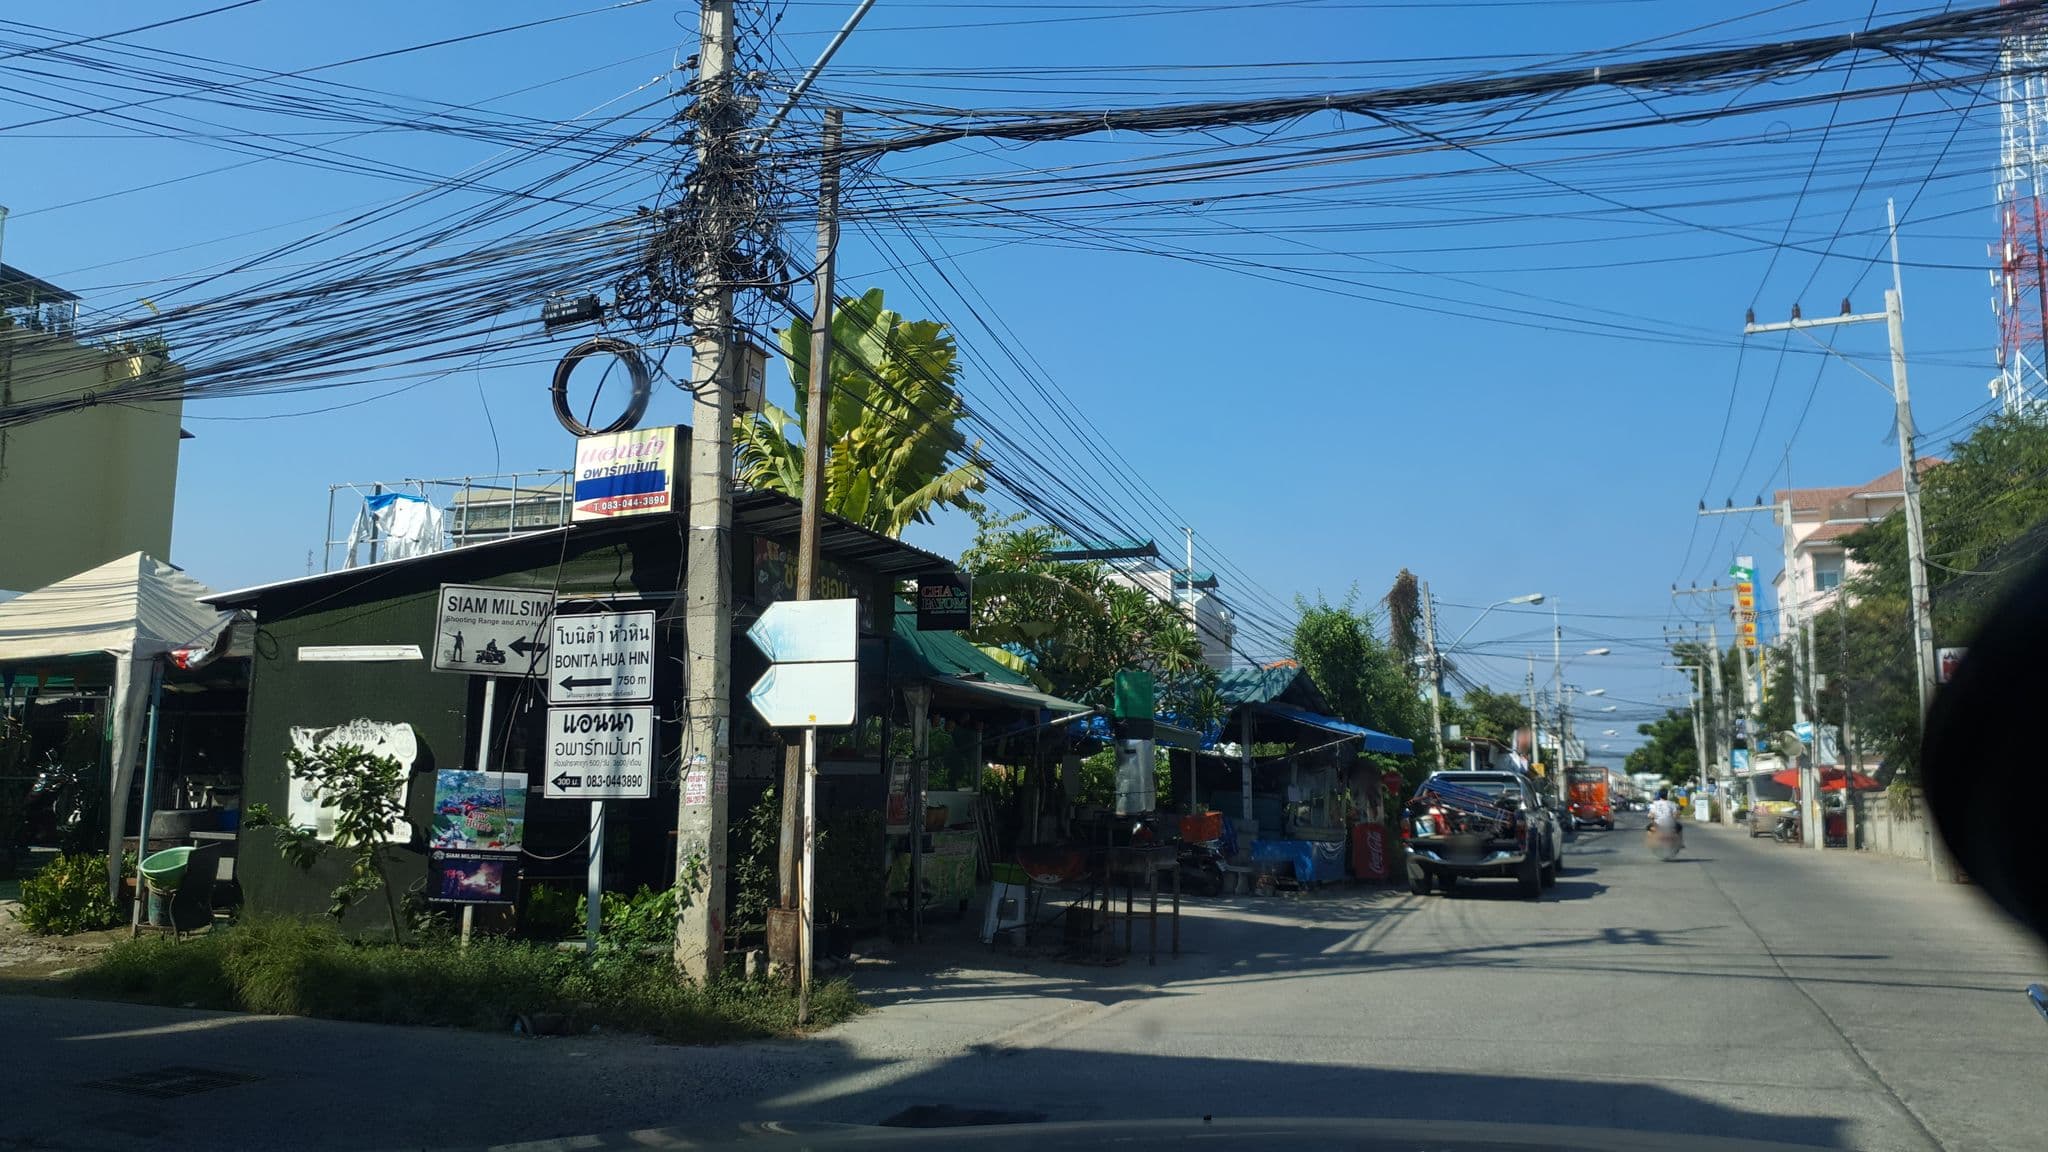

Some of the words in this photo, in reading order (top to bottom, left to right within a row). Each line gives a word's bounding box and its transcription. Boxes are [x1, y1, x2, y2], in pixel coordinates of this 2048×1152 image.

[448, 596, 487, 614] SIAM
[492, 599, 550, 617] MILSIM
[445, 615, 477, 625] Shooting
[479, 617, 500, 626] Range
[515, 619, 530, 627] ATV
[557, 624, 604, 645] โบนิต้า
[609, 622, 650, 643] หัวหิน
[555, 653, 598, 669] BONITA
[601, 652, 626, 667] HUA
[629, 651, 649, 666] HIN
[617, 675, 636, 686] 750
[637, 676, 647, 685] m
[563, 712, 634, 734] แอนนา
[555, 736, 645, 756] อพาร์ทเม้นท์
